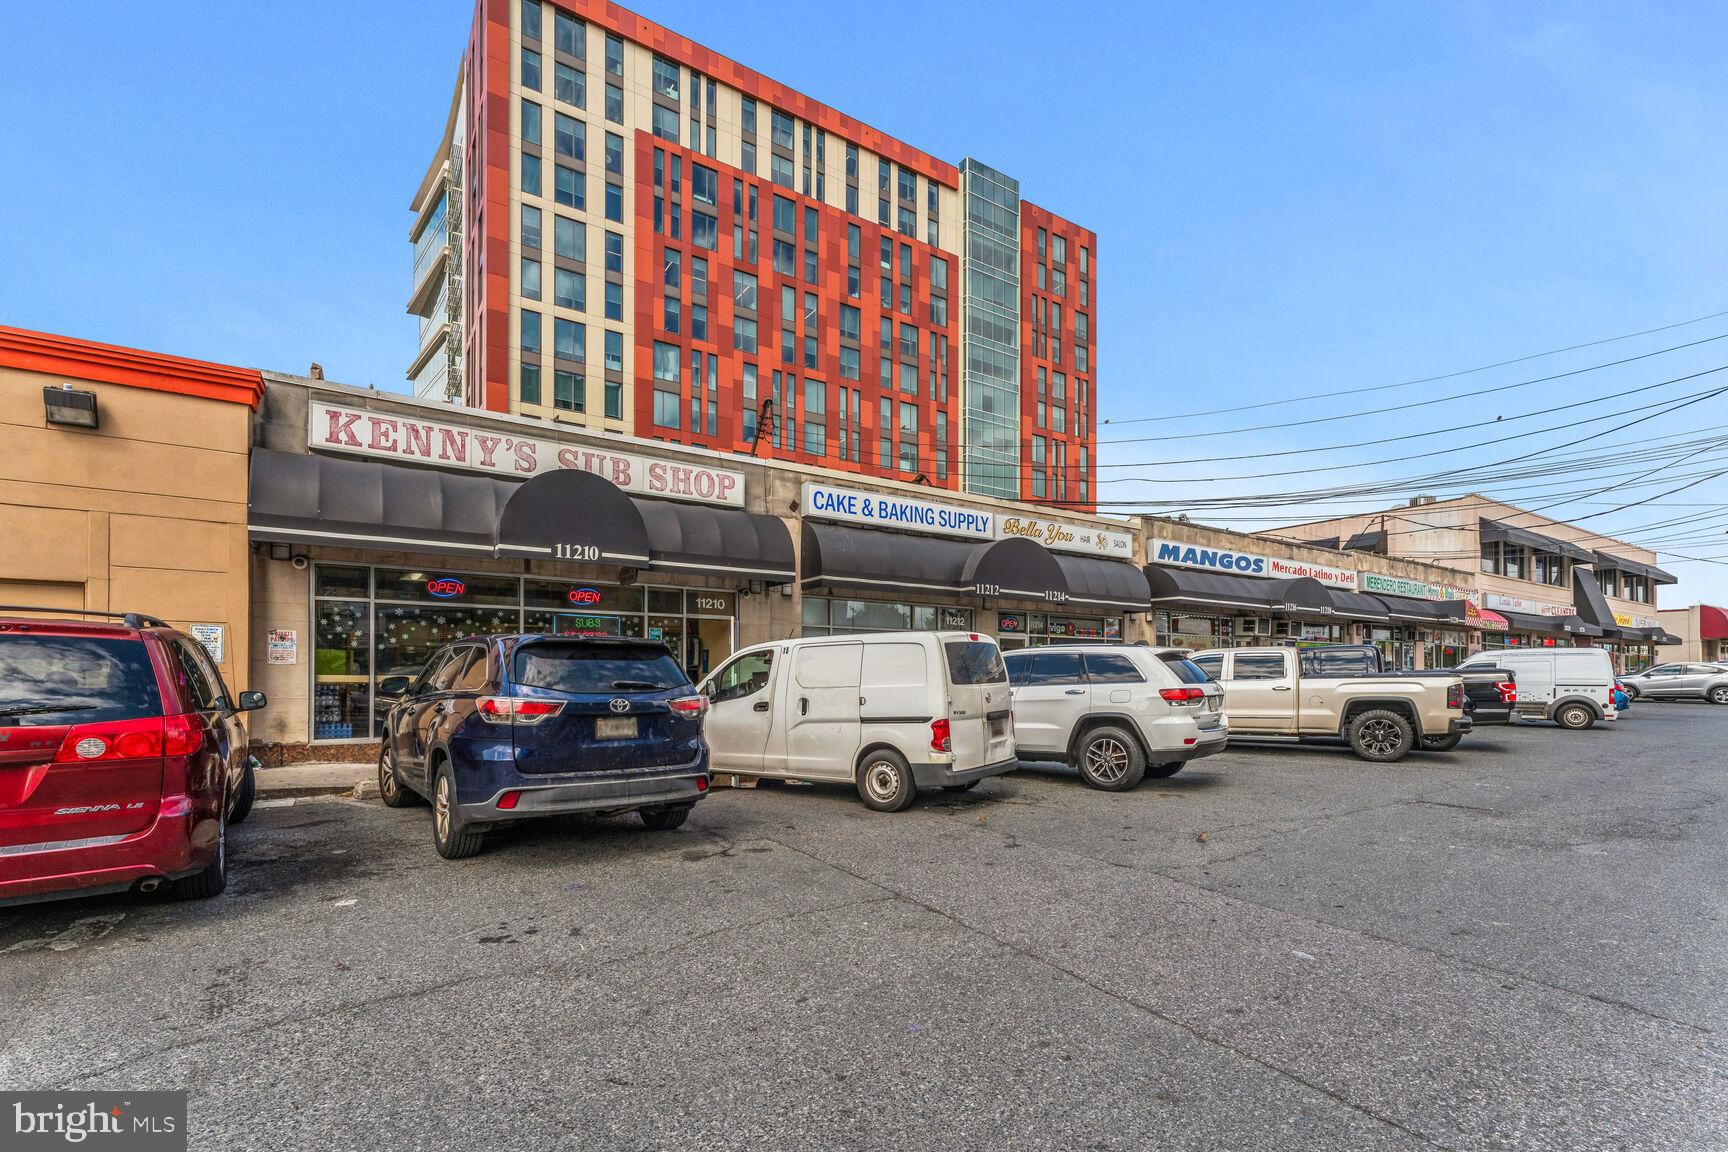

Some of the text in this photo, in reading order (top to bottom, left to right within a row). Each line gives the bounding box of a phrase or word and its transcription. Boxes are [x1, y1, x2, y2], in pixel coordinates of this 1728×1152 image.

[325, 409, 736, 501] KENNY'S SUB SHOP
[813, 490, 989, 533] CAKE & BAKING SUPPLY
[1003, 518, 1044, 539] Bella
[1045, 524, 1075, 546] You
[1113, 540, 1127, 549] SALON
[555, 543, 600, 561] 11210
[1158, 543, 1265, 573] MANGOS
[1272, 561, 1355, 584] Mercado Latino y Deli
[428, 581, 465, 595] OPEN
[976, 584, 1000, 596] 11212
[569, 591, 600, 604] OPEN
[1045, 590, 1065, 601] 11214
[695, 598, 725, 610] 11210
[575, 618, 601, 628] SUBS
[946, 617, 965, 626] 11212
[1001, 620, 1018, 628] OPEN
[54, 803, 120, 815] SIENNA
